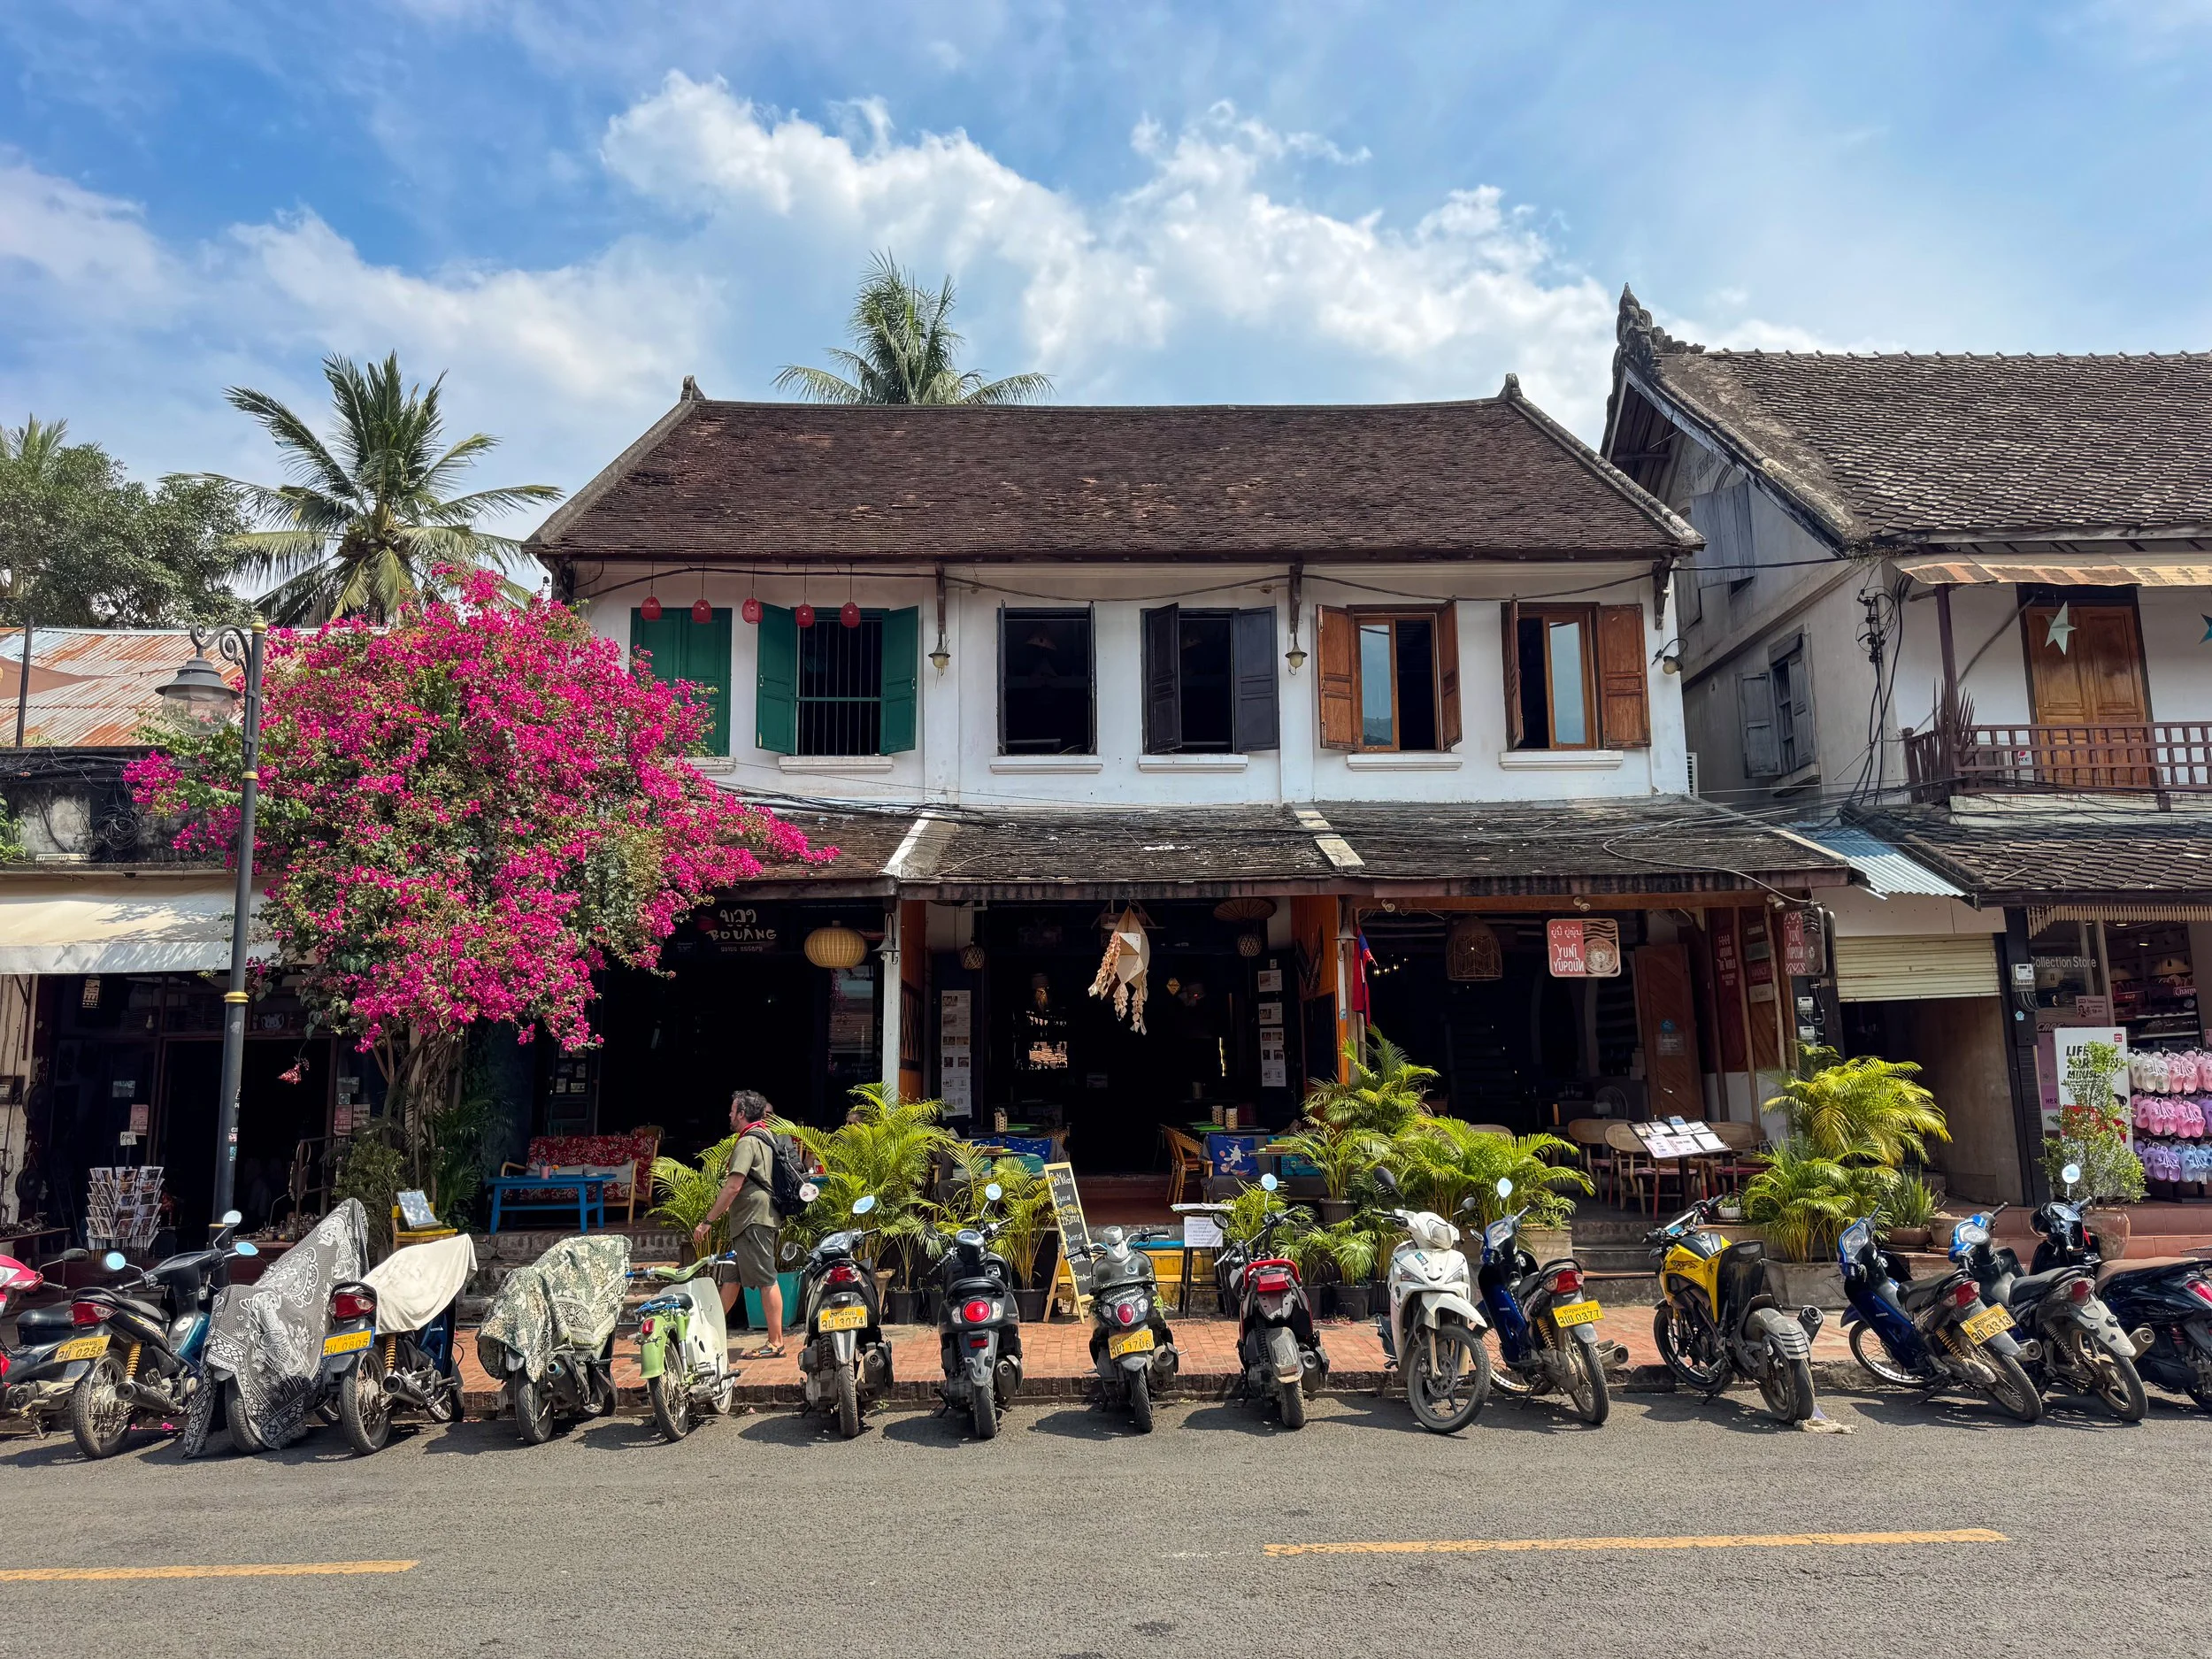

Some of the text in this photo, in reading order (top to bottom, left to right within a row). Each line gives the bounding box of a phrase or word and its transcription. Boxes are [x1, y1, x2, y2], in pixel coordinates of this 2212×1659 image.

[706, 929, 777, 941] BOUANG
[1554, 943, 1578, 958] YUNI
[2072, 956, 2097, 968] Store
[839, 1316, 864, 1328] 3074
[1575, 1310, 1600, 1322] 0377
[1986, 1315, 2012, 1333] 3313
[75, 1346, 104, 1358] 0258
